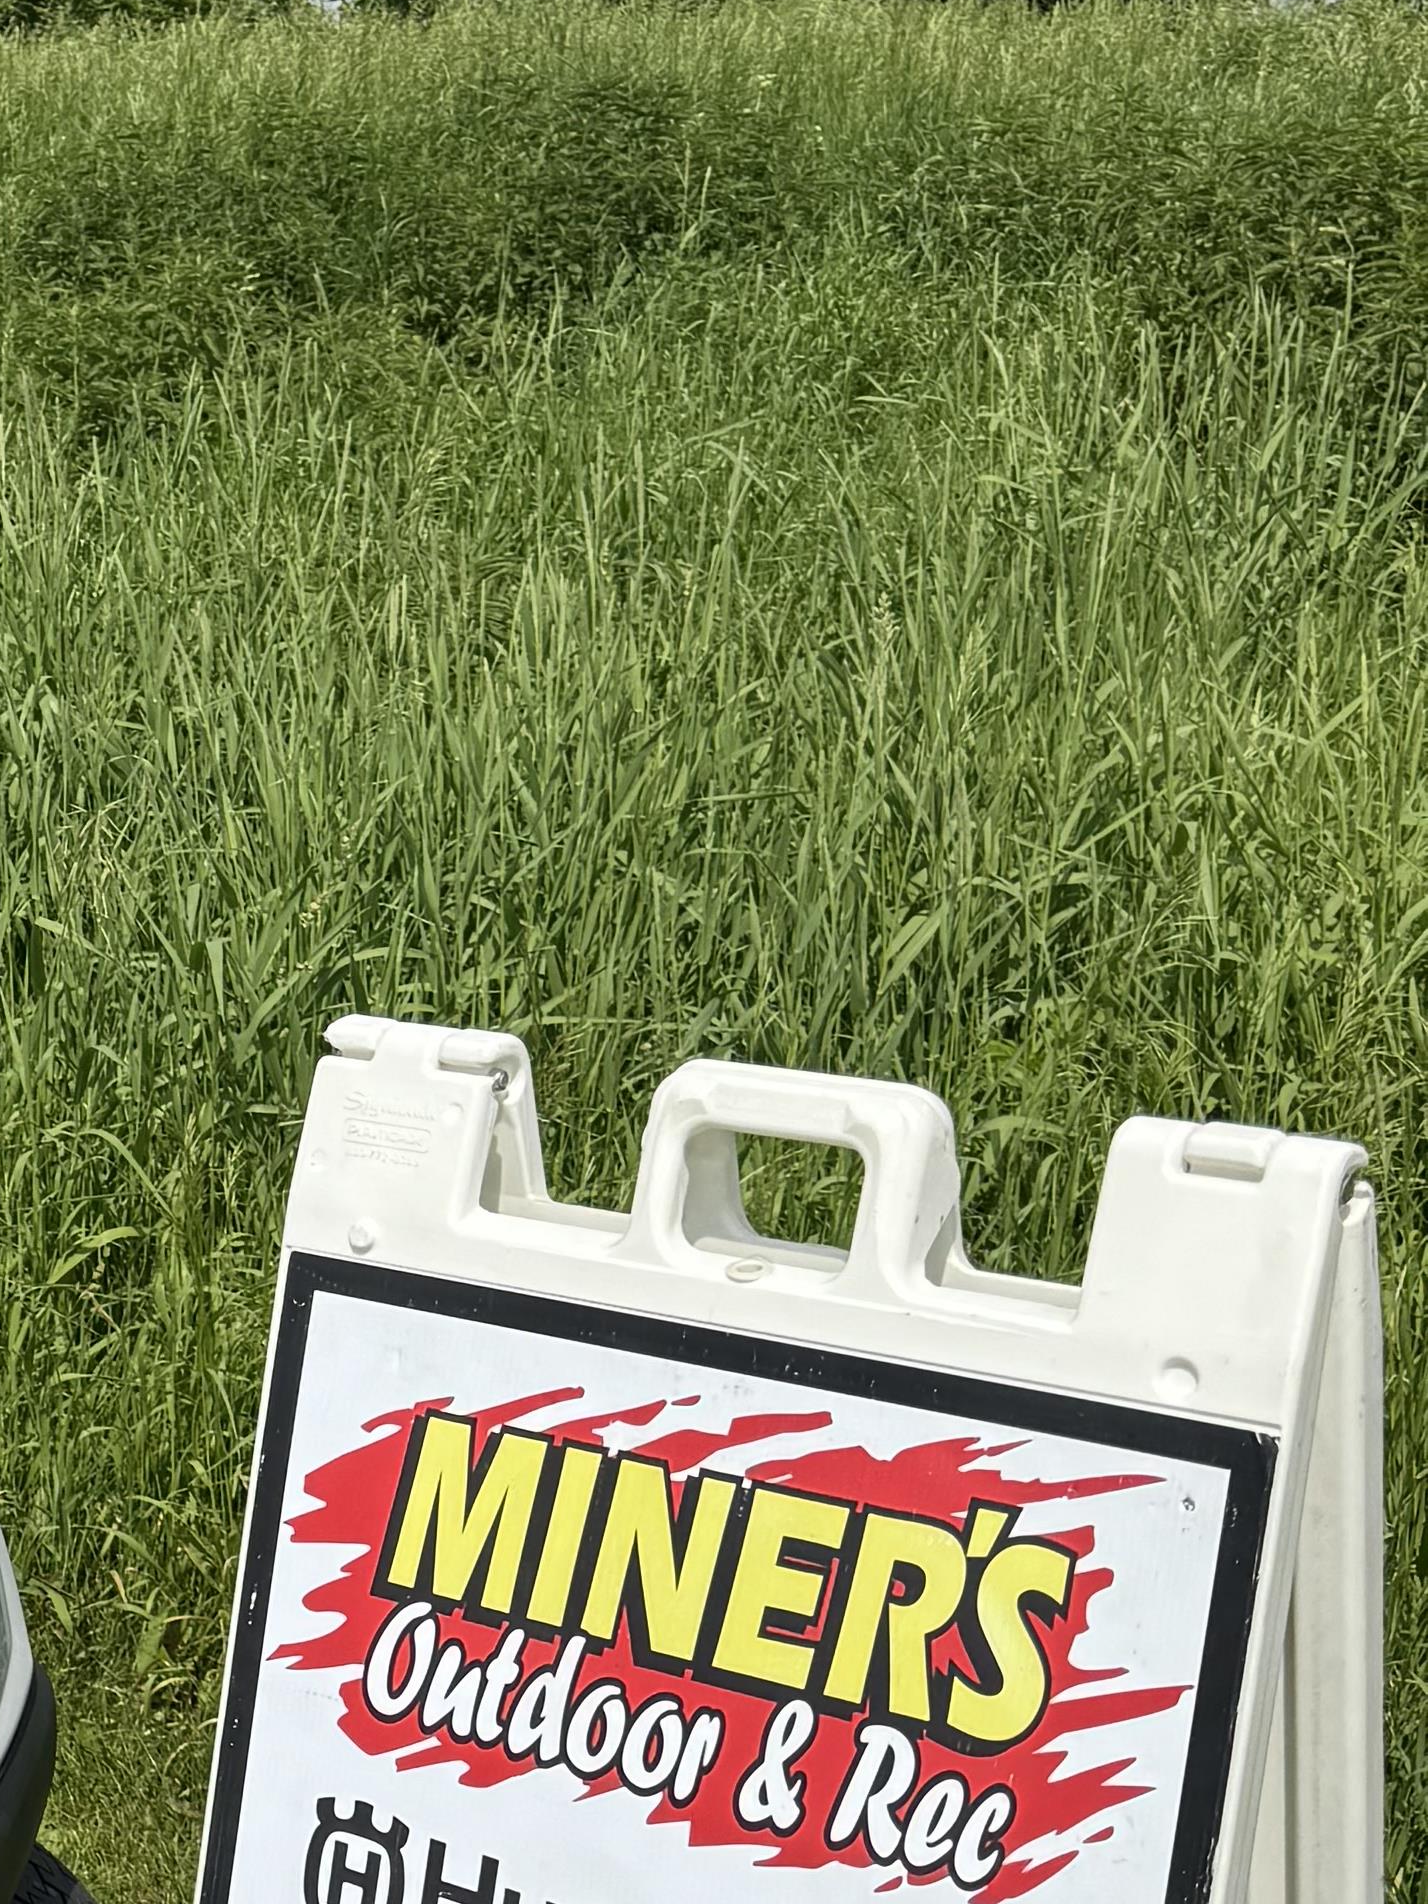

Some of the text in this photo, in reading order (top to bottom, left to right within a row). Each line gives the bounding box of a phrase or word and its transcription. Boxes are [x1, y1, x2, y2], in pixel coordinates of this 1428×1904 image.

[374, 1411, 1075, 1748] MINER'S
[365, 1601, 1016, 1887] Outdoor & Rec
